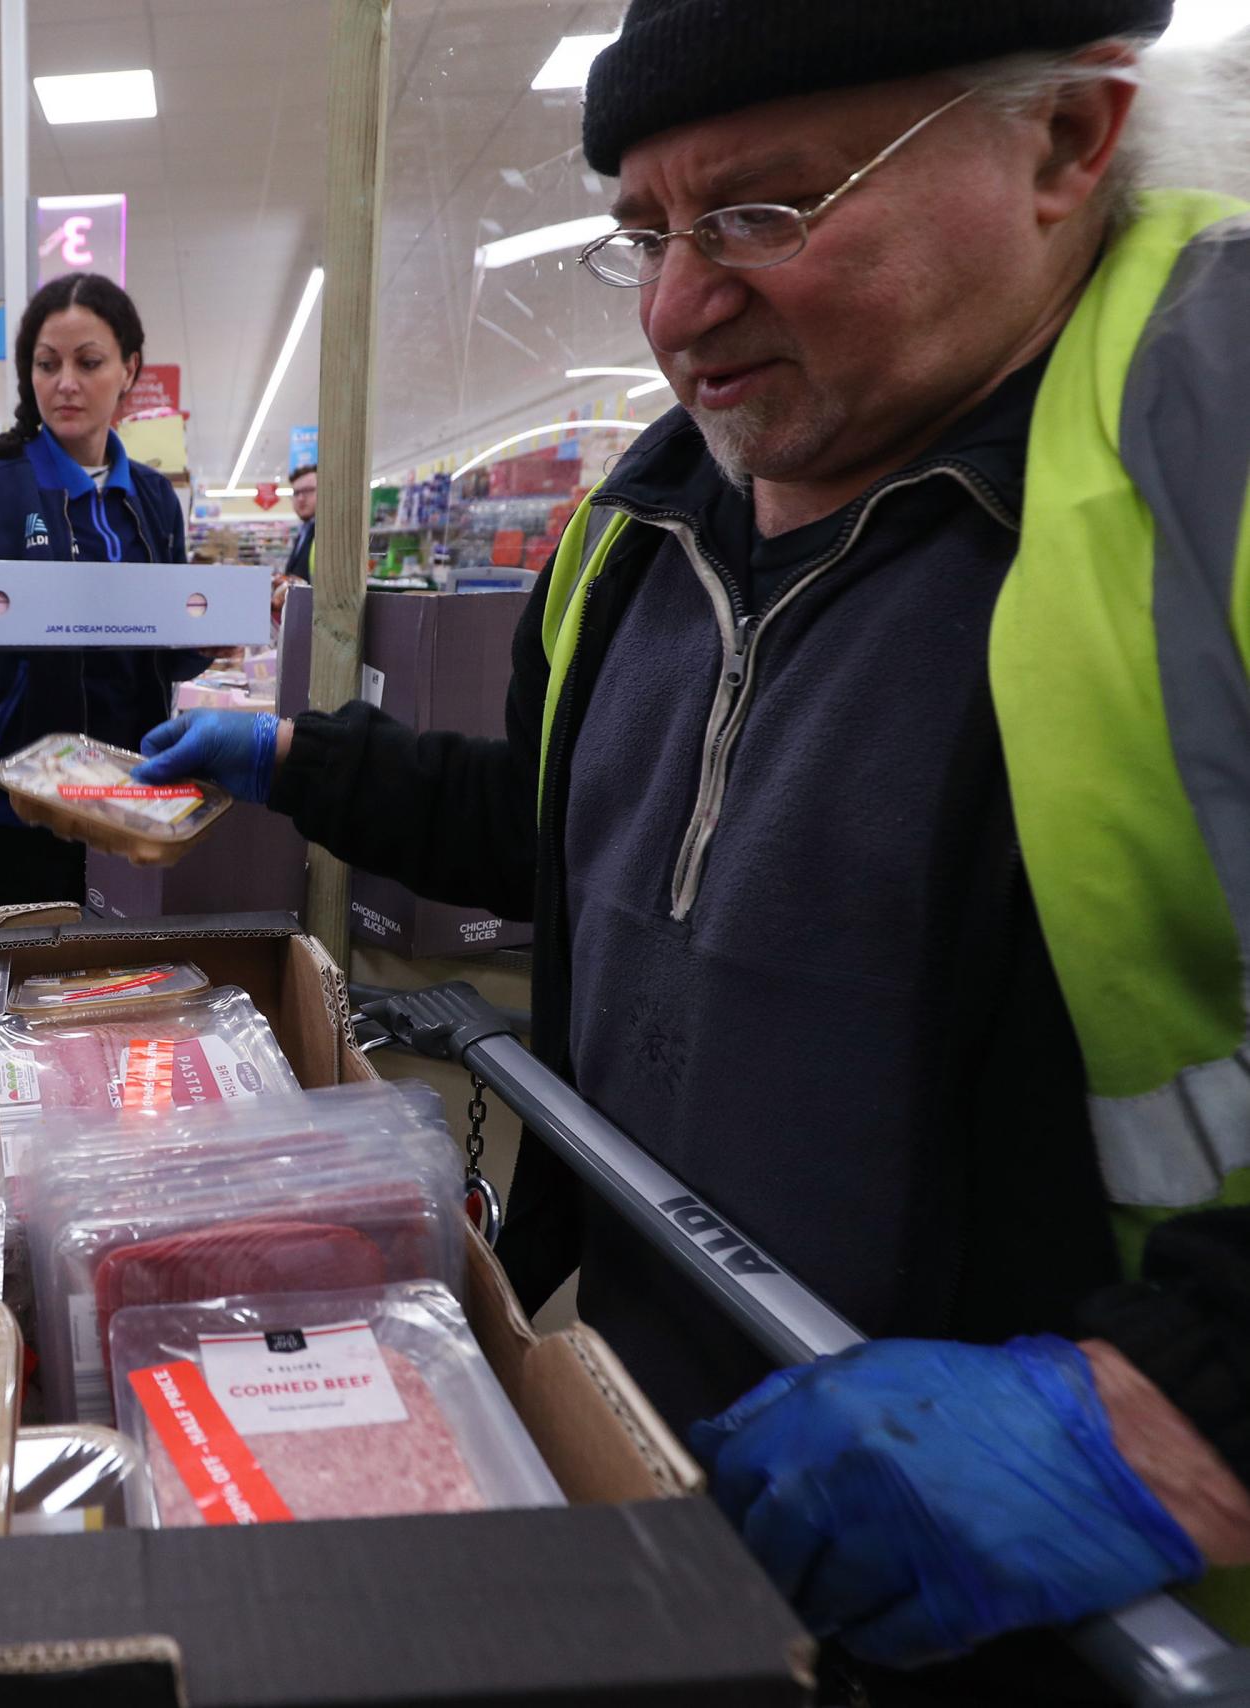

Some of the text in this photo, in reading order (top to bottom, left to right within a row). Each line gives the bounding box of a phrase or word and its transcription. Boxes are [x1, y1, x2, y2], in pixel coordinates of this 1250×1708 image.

[45, 625, 158, 633] JAM & CREAM DOUGHNUTS
[352, 902, 402, 934] CHICKEN TIKKA
[362, 917, 386, 936] SLICES
[459, 919, 503, 934] CHICKEN
[464, 929, 497, 943] SLICES
[176, 1055, 207, 1102] PASTRA
[215, 1064, 239, 1099] BRITISH
[657, 1194, 782, 1276] ALDI
[152, 1369, 186, 1409] PRICE
[229, 1375, 374, 1398] CORNED BEEF
[174, 1408, 208, 1447] HALF
[201, 1456, 231, 1484] OFF
[222, 1482, 259, 1525] 50%
